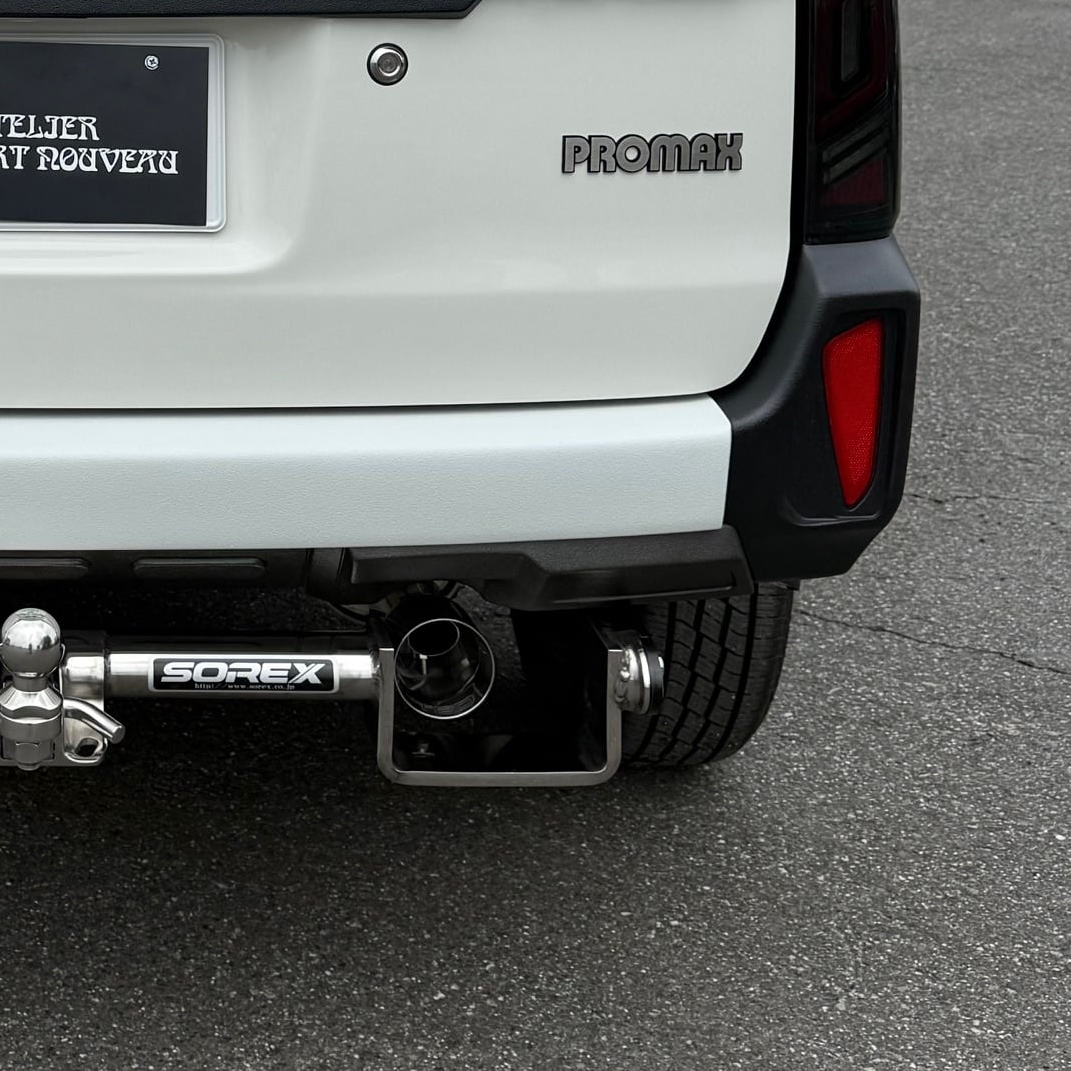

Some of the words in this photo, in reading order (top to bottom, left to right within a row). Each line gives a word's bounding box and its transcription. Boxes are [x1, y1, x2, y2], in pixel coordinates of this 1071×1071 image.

[37, 146, 180, 175] NOUVEAU
[562, 133, 744, 174] PROMAX
[160, 661, 326, 685] SOREX
